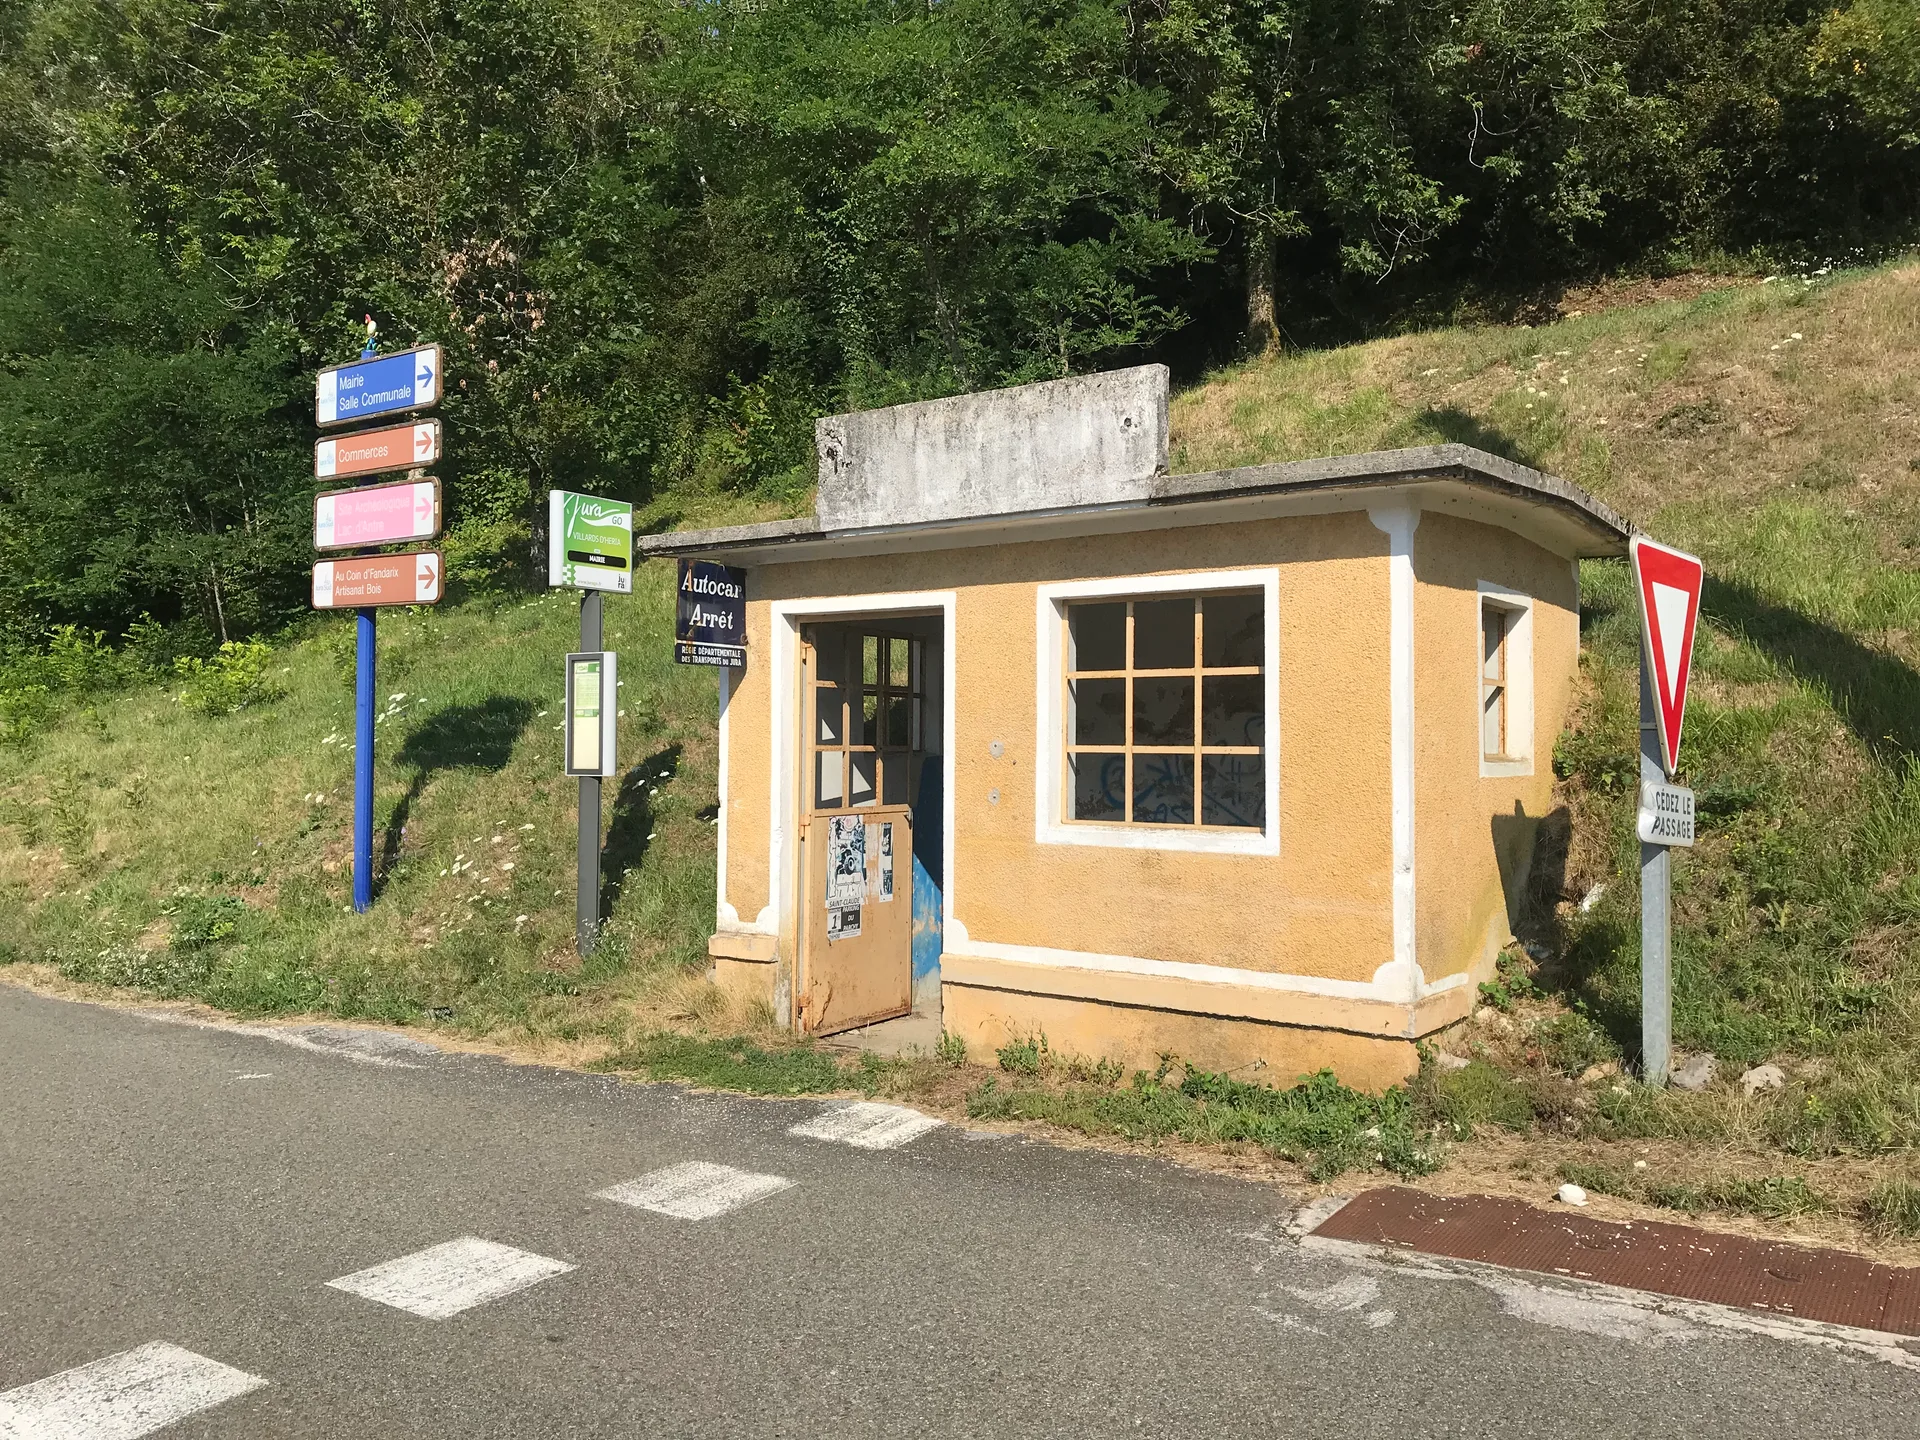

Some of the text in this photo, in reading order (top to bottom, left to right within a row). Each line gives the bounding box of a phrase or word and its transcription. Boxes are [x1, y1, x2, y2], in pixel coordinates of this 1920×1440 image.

[340, 374, 364, 390] Mairie
[339, 397, 358, 411] Salle
[361, 385, 411, 407] Communale
[338, 445, 388, 462] Commerces
[612, 516, 623, 526] GO
[572, 531, 599, 543] VILLARDS
[589, 555, 605, 563] MAIRIE
[335, 570, 344, 581] Au
[346, 568, 361, 580] Coin
[335, 583, 381, 596] Artisanat Bois
[681, 569, 742, 598] Autocar
[689, 603, 734, 630] Arrêt
[698, 645, 741, 658] DÉPARTEMENTALE
[681, 655, 690, 663] DES
[692, 656, 722, 665] TRANSPORTS
[730, 658, 742, 667] JURA
[1655, 788, 1691, 815] CÉDEZ LE
[1650, 815, 1691, 839] PASSAGE
